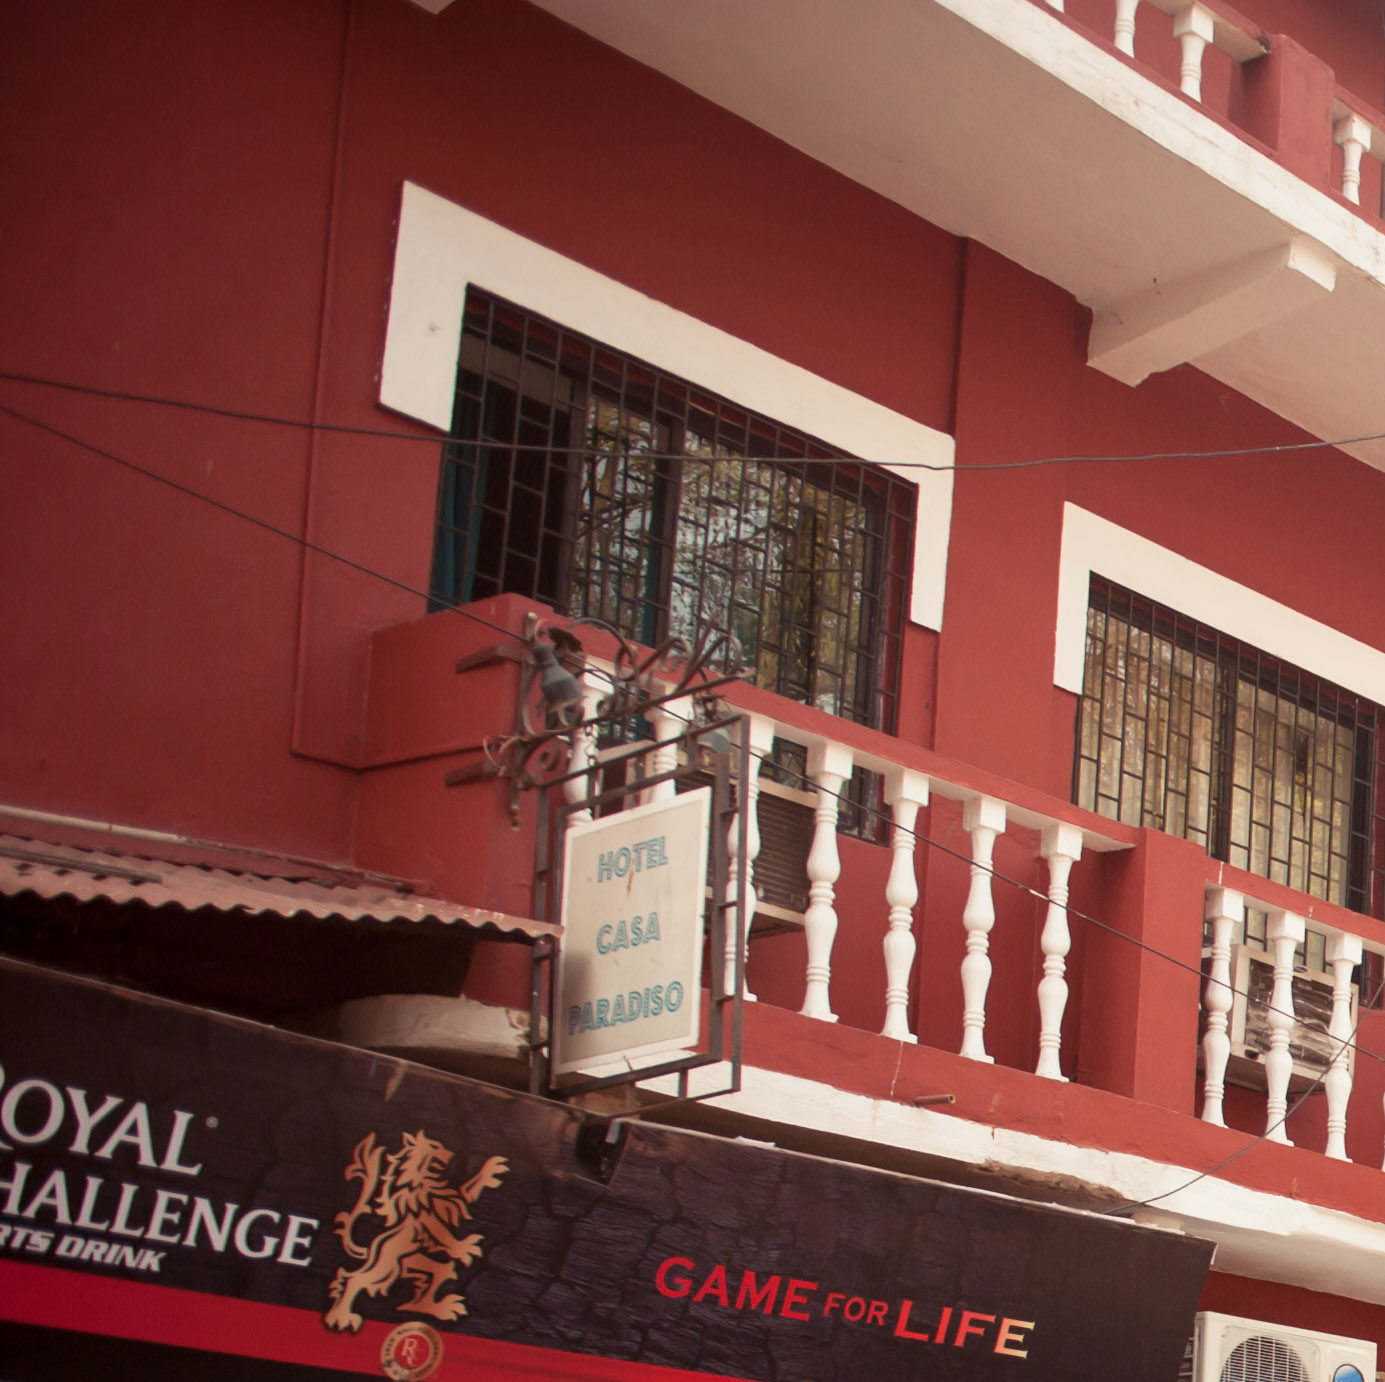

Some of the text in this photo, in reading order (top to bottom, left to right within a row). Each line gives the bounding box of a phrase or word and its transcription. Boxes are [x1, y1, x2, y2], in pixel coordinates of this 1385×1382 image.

[597, 835, 668, 884] HOTEL
[597, 912, 660, 955] CASA
[568, 980, 683, 1036] PARADISO
[0, 1160, 320, 1267] HALLENGE
[55, 1233, 167, 1272] DRINK
[655, 1256, 1035, 1359] GAME FOR LIFE
